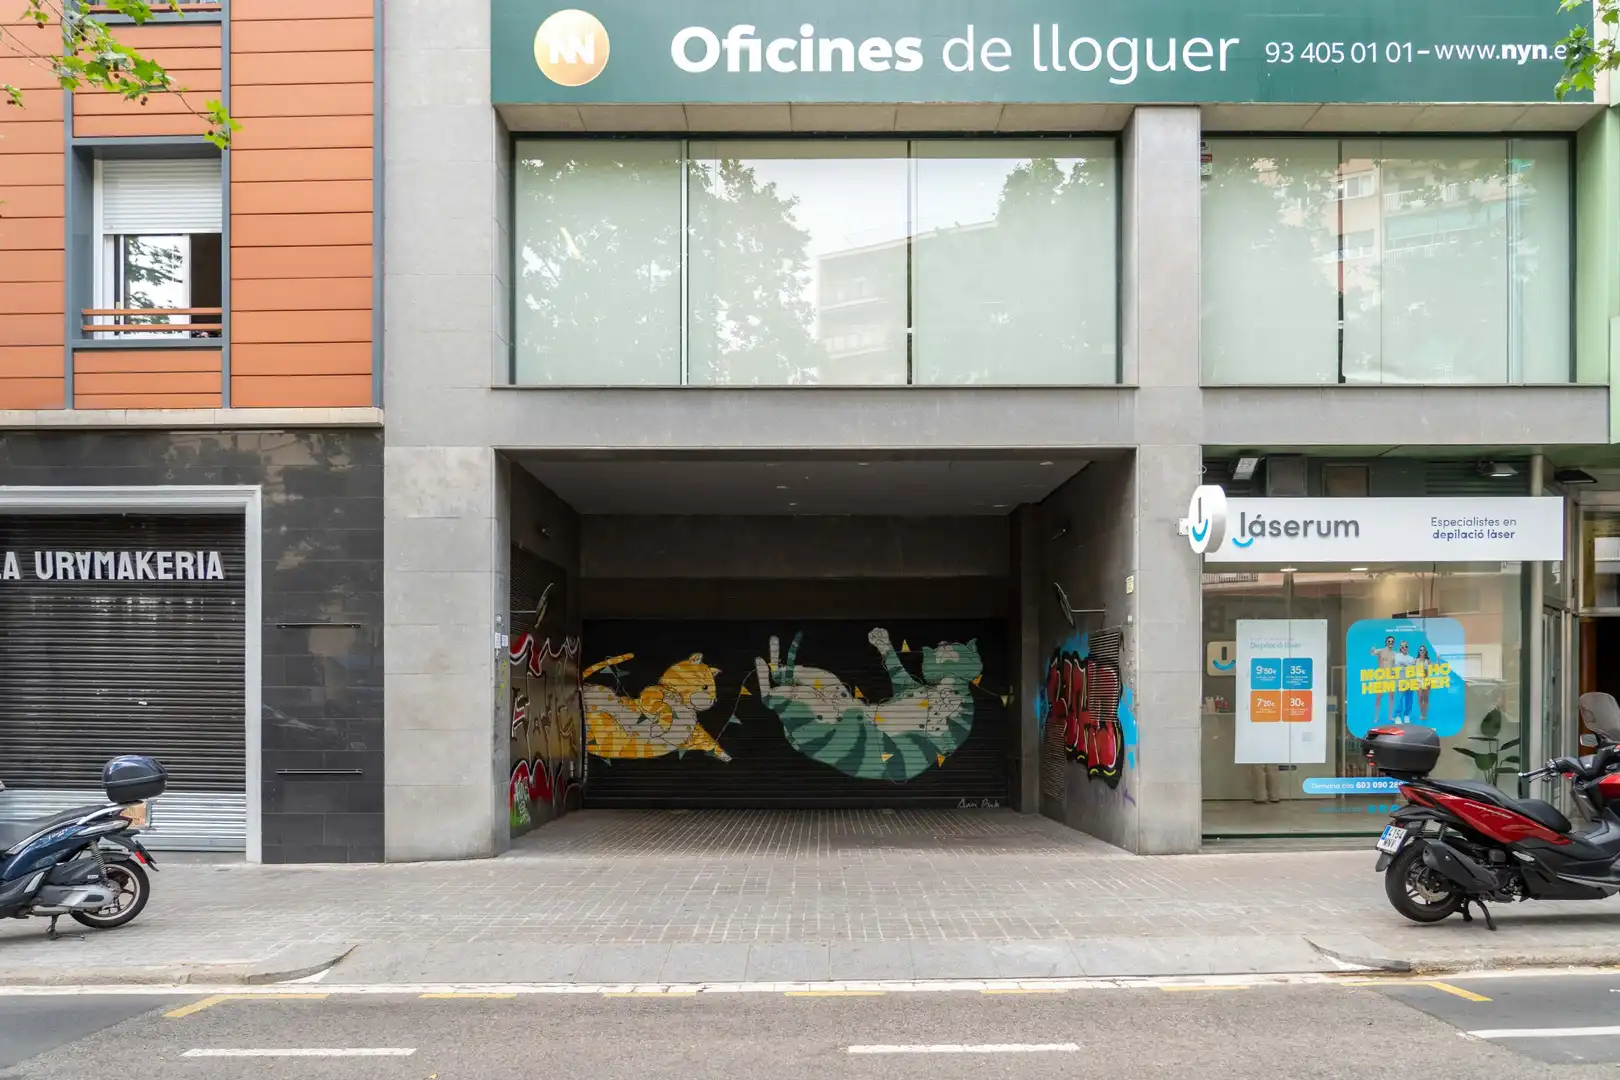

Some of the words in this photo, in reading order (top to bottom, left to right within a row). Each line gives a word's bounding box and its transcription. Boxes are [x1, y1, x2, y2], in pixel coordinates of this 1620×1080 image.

[670, 23, 924, 73] Oficines
[942, 24, 1012, 72] de
[1033, 23, 1240, 85] lloguer
[1265, 41, 1294, 63] 93
[1300, 42, 1345, 63] 405
[1350, 42, 1377, 63] 01
[1239, 511, 1360, 538] láserum
[1430, 516, 1500, 529] Especialistes
[1502, 519, 1517, 527] en
[1432, 529, 1484, 542] depilació
[1360, 666, 1402, 682] MOLT
[1361, 680, 1396, 695] HEM
[1398, 679, 1420, 692] DE
[1356, 781, 1371, 789] 603
[1372, 781, 1388, 789] 090
